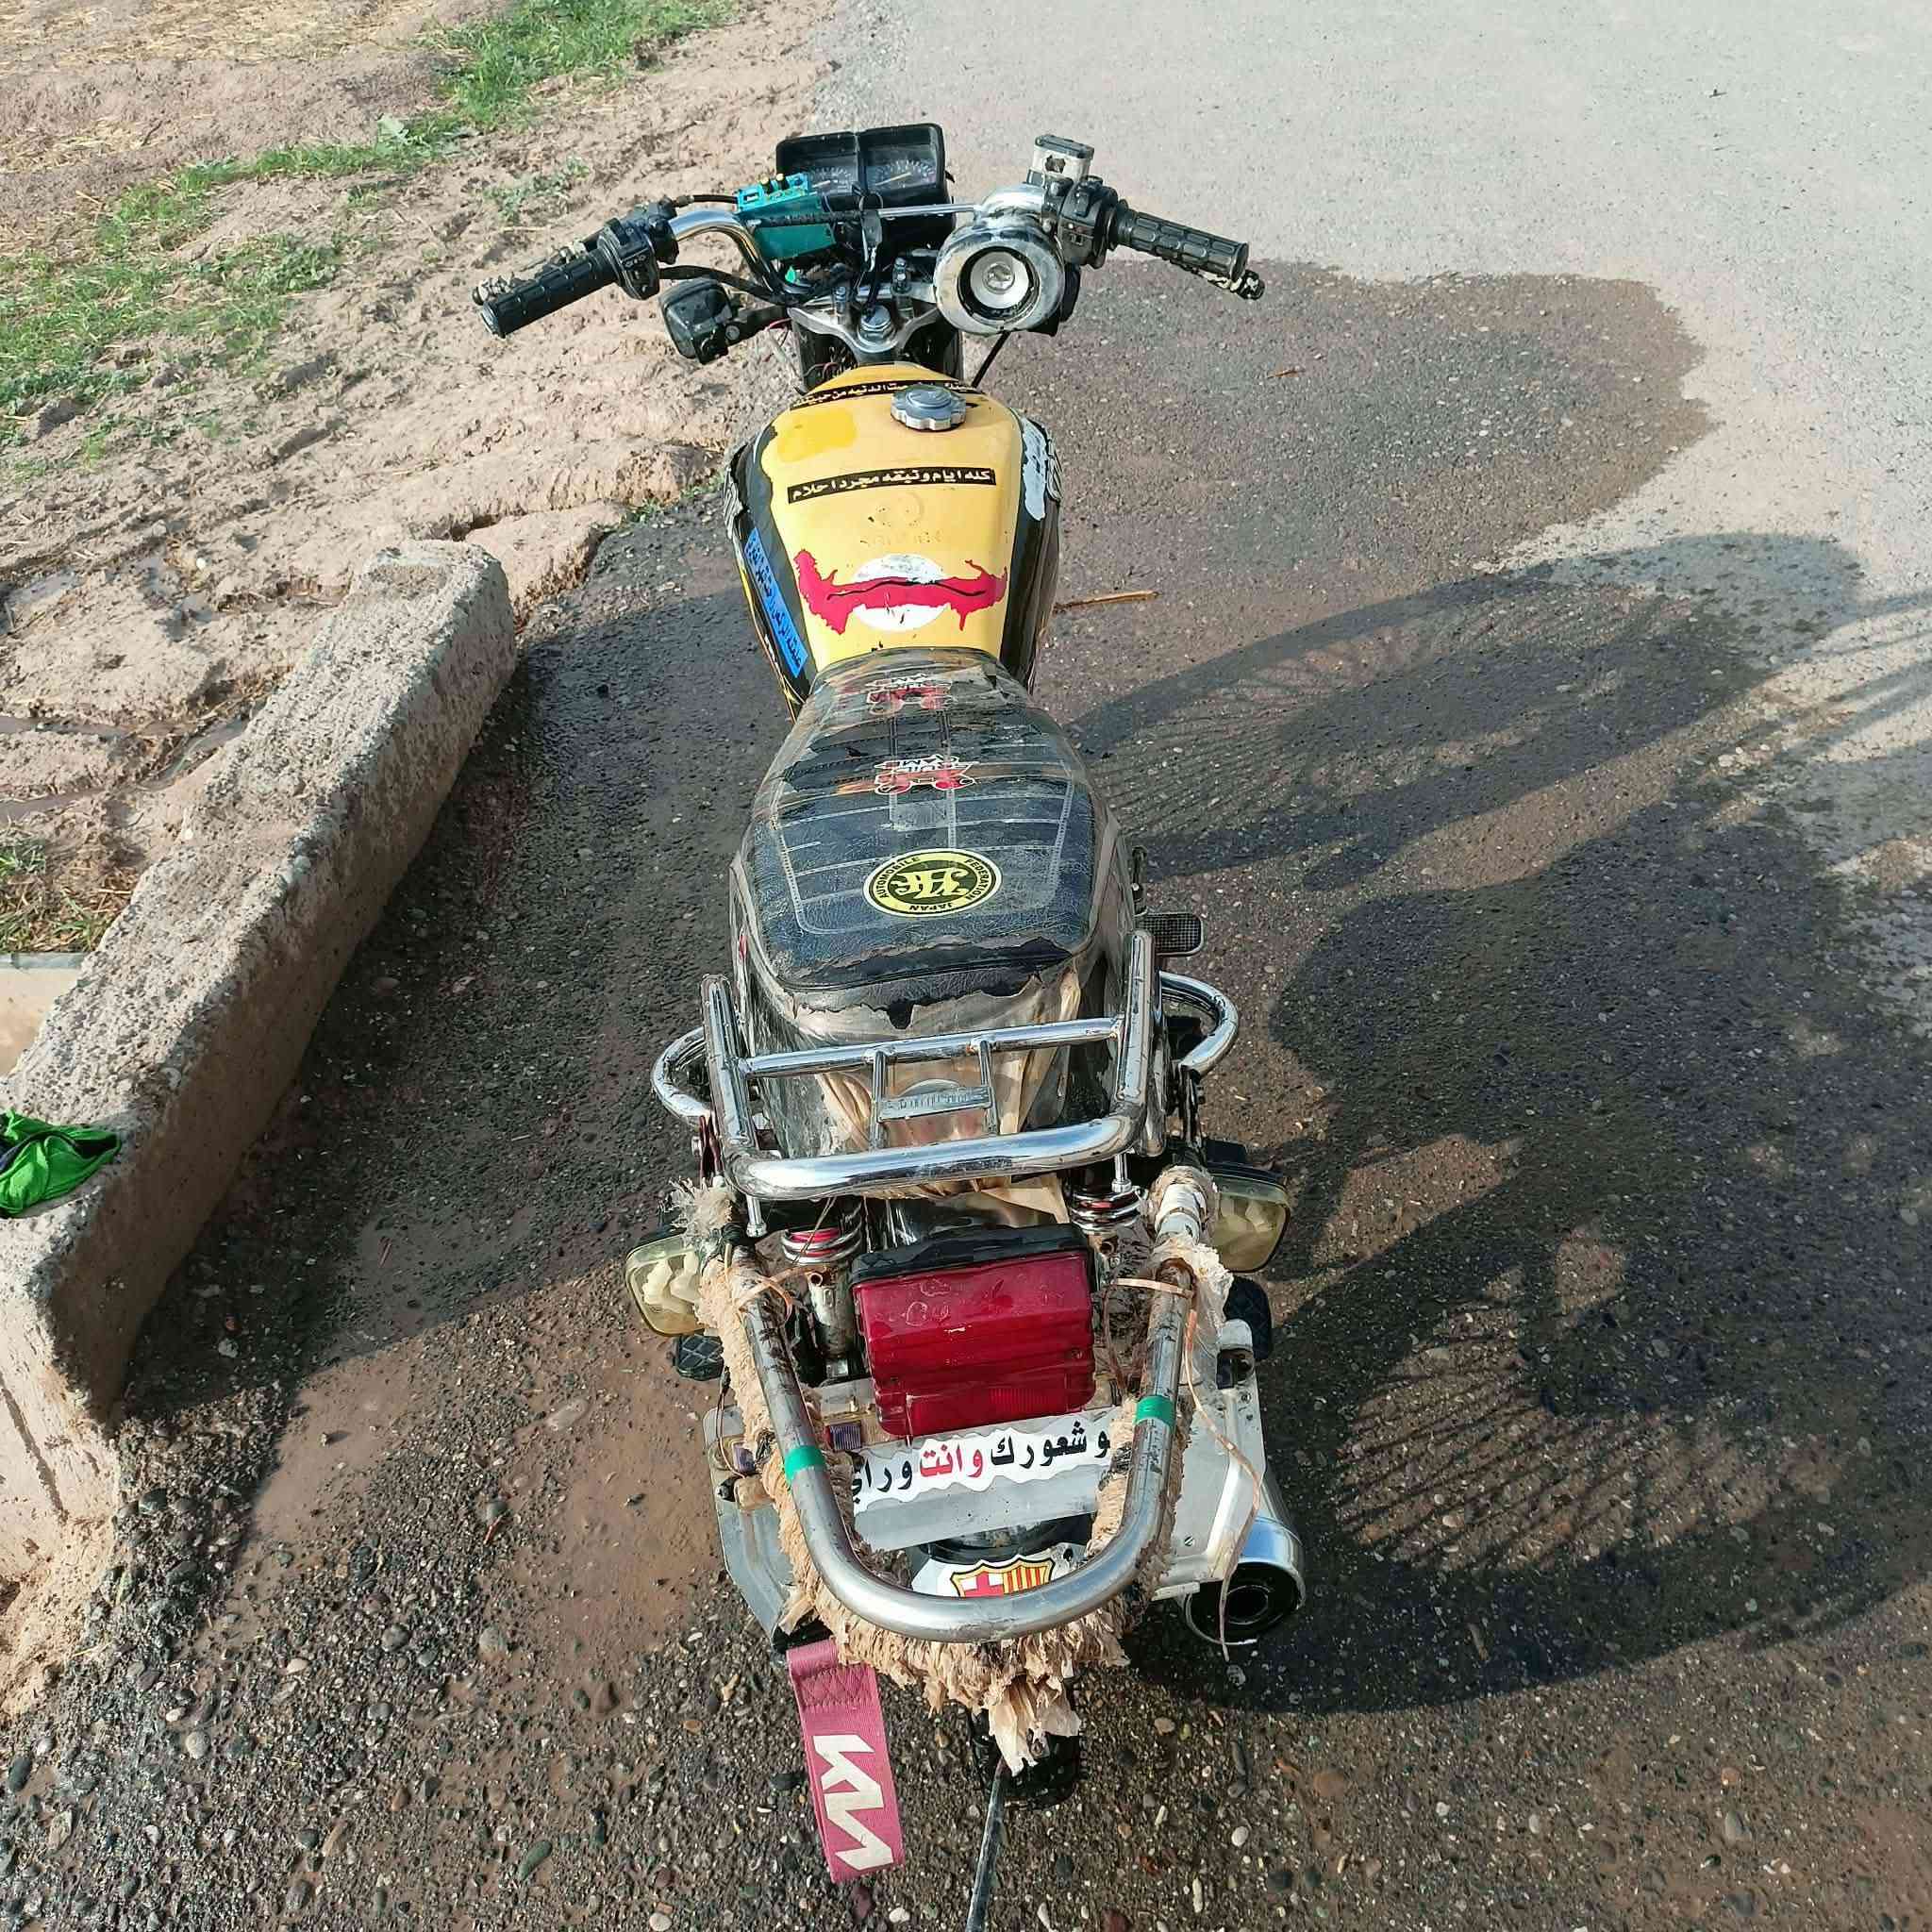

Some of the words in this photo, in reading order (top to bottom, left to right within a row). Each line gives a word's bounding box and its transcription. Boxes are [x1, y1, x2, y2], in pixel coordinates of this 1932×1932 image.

[875, 857, 921, 899] AUTOMOBILE
[964, 858, 991, 902] FEDERATION
[908, 902, 953, 912] JAPAN
[920, 1443, 984, 1478] وانت
[991, 1420, 1088, 1469] شعورك
